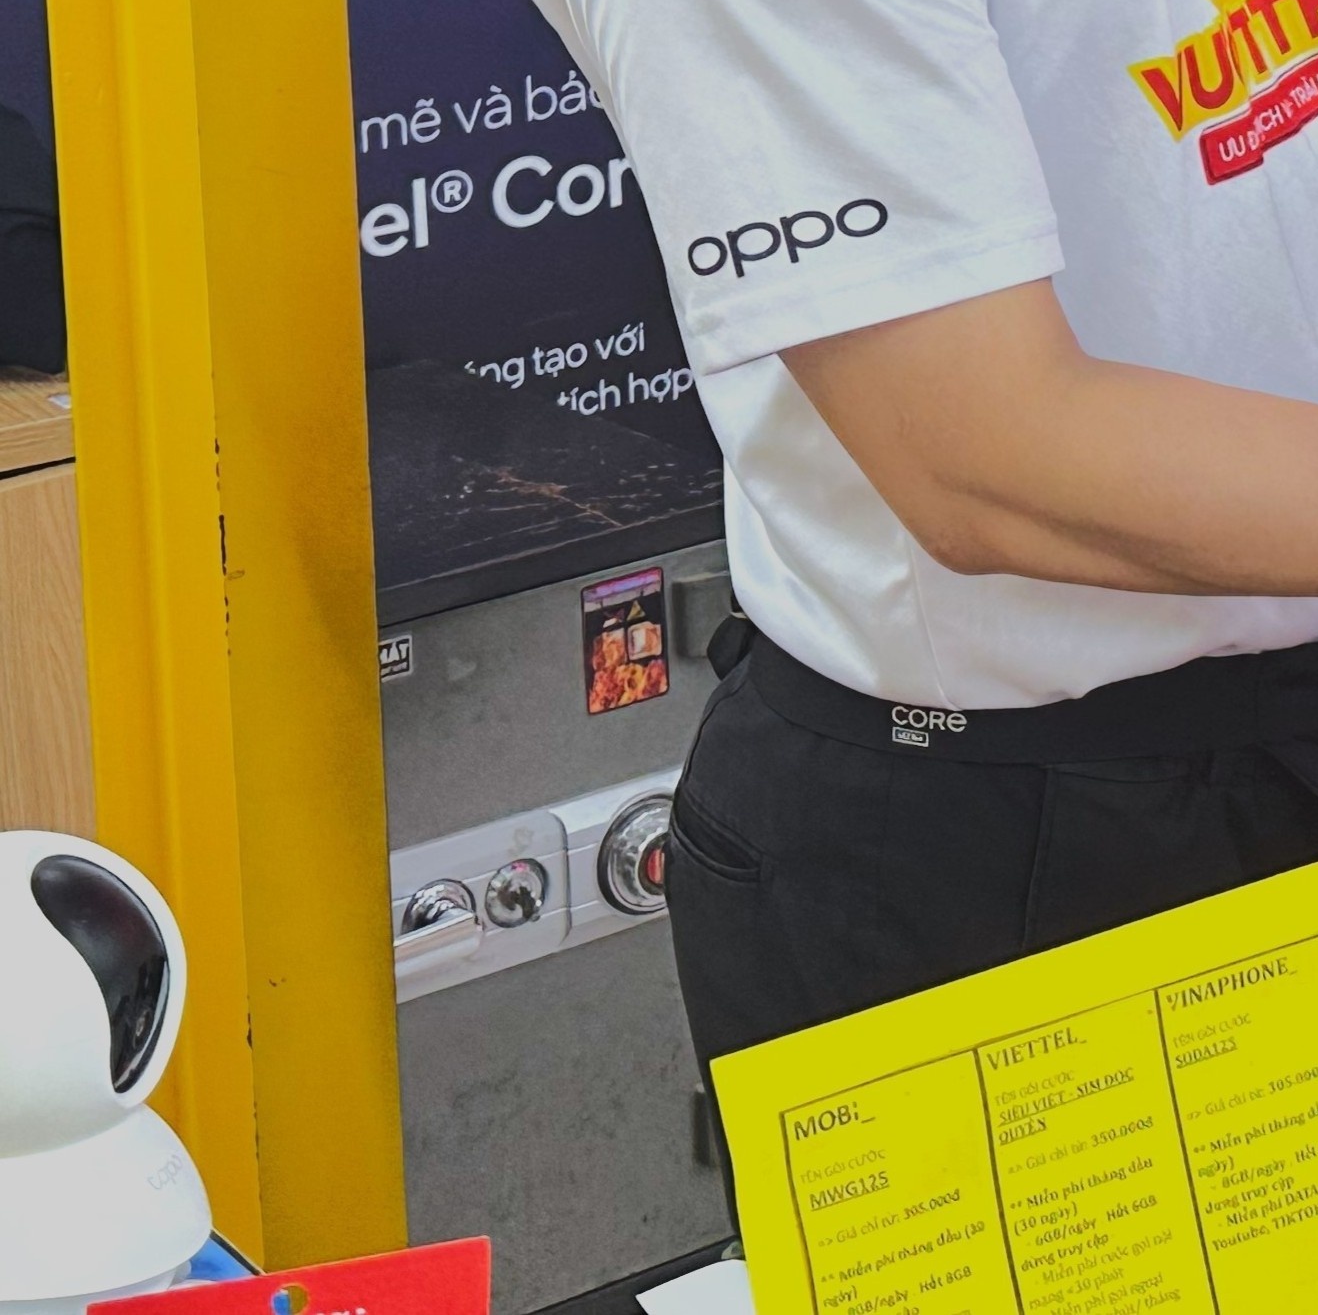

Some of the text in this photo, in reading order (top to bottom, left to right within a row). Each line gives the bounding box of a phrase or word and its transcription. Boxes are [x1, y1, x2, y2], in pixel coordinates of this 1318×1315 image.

[360, 97, 442, 153] mẽ
[453, 85, 512, 134] và
[687, 197, 889, 279] oppo
[531, 342, 589, 378] tạo
[594, 321, 645, 361] với
[628, 367, 694, 404] hợp
